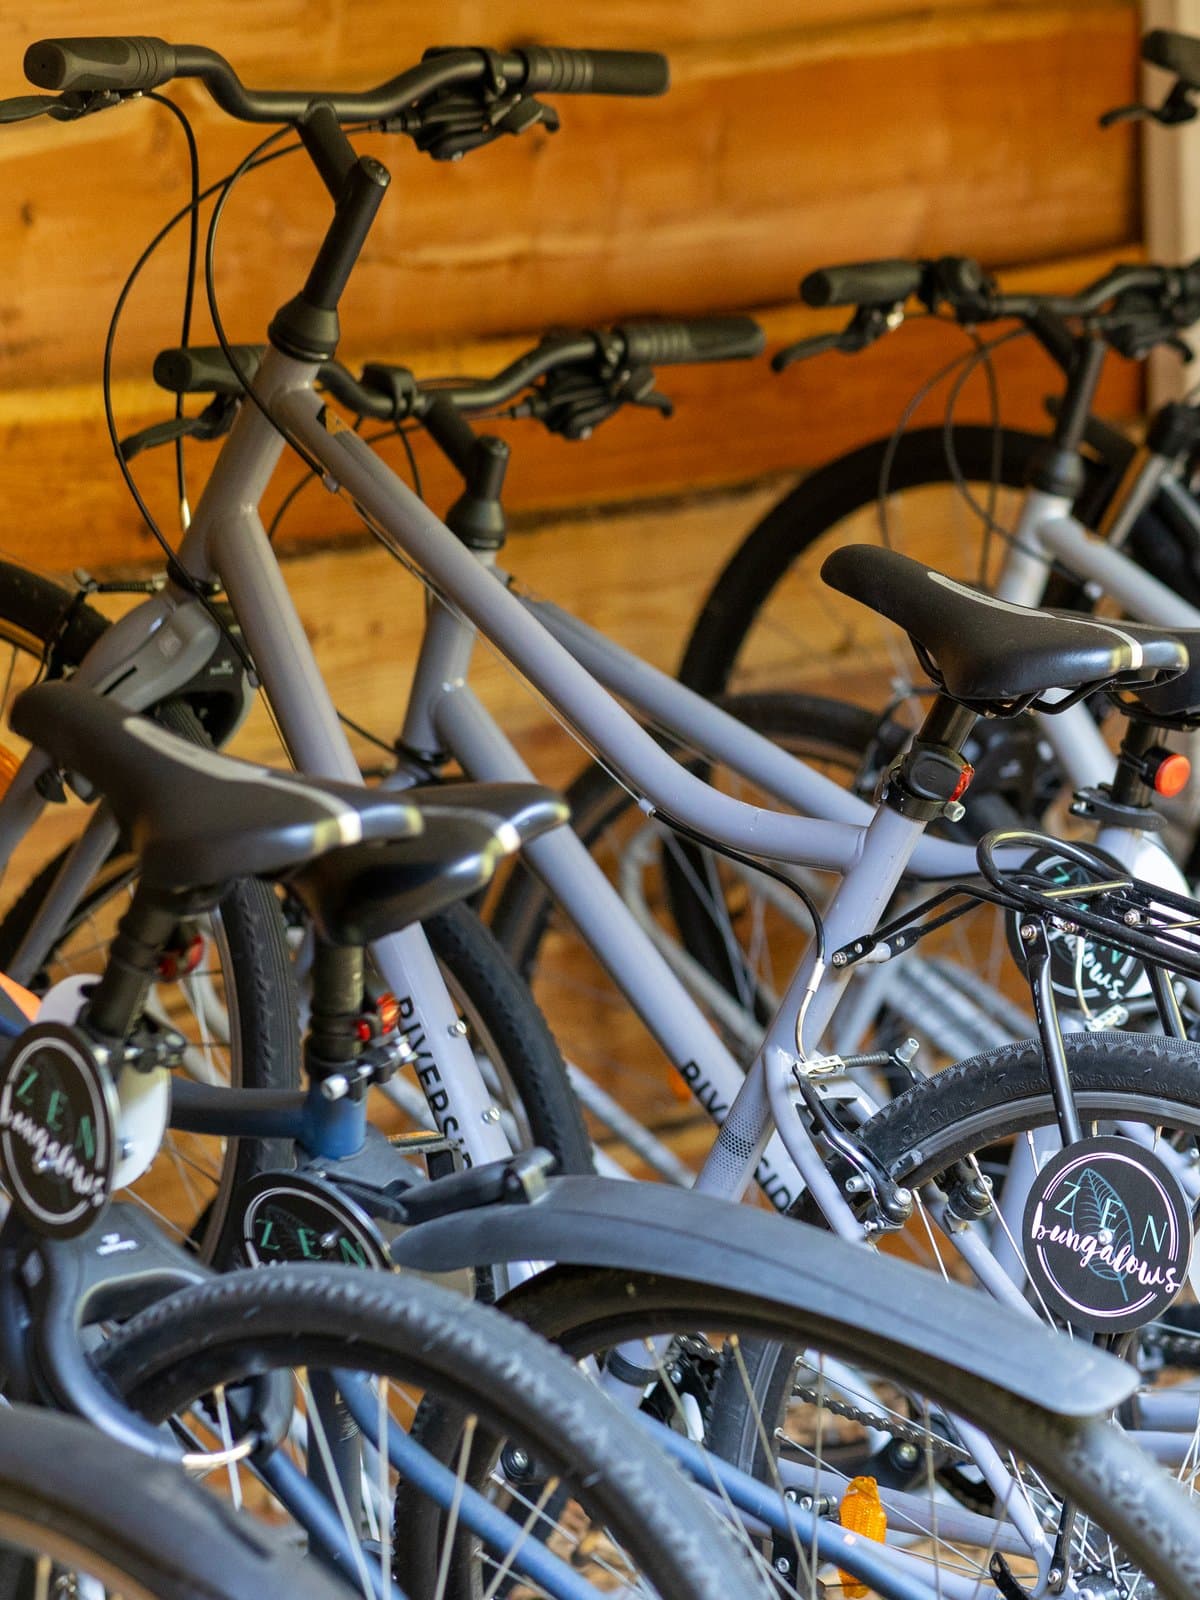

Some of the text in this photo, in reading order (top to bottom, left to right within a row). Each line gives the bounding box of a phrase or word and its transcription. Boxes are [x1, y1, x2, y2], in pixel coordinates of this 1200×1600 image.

[16, 1065, 97, 1161] ZEN
[256, 1218, 367, 1271] ZEN
[1031, 1201, 1182, 1294] bungalows
[1054, 1180, 1169, 1254] ZEN
